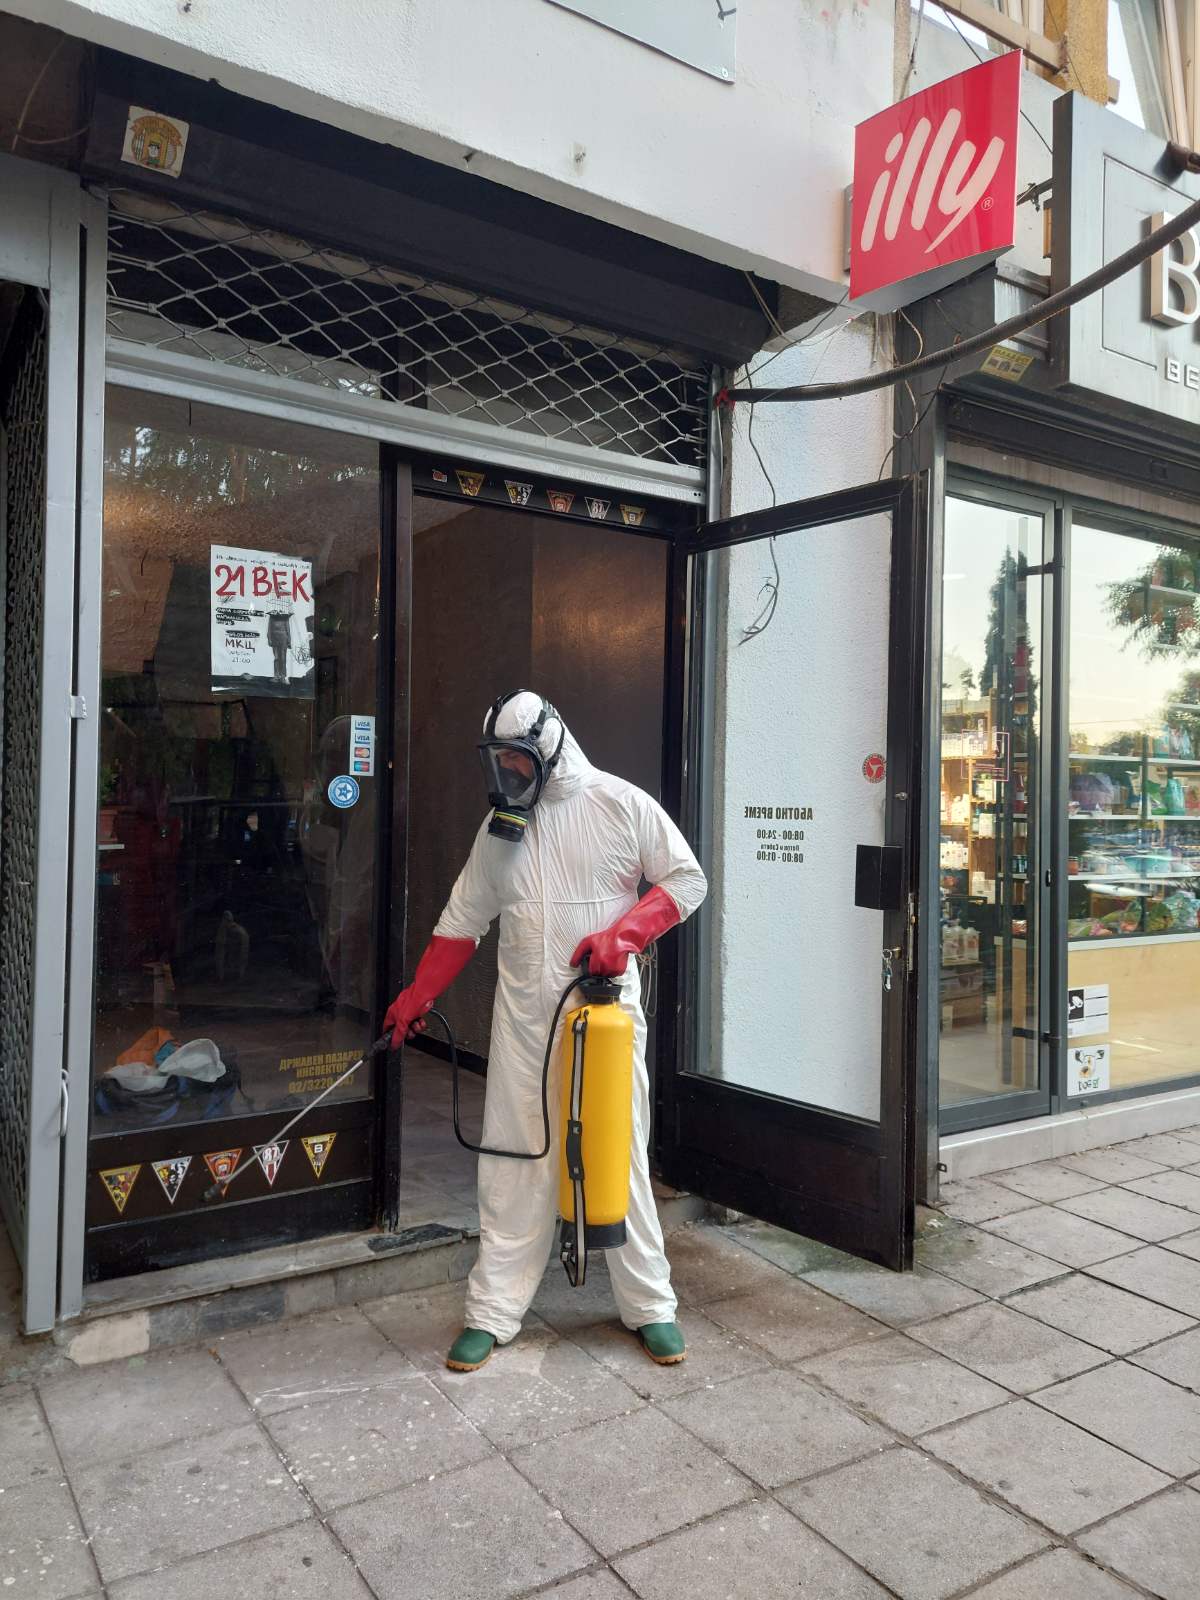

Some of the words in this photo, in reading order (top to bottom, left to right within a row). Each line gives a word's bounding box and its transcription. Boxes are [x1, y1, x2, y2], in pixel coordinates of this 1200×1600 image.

[861, 108, 1005, 254] illy
[215, 564, 245, 597] 21
[252, 566, 310, 602] ВЕК
[225, 638, 255, 653] МКЦ
